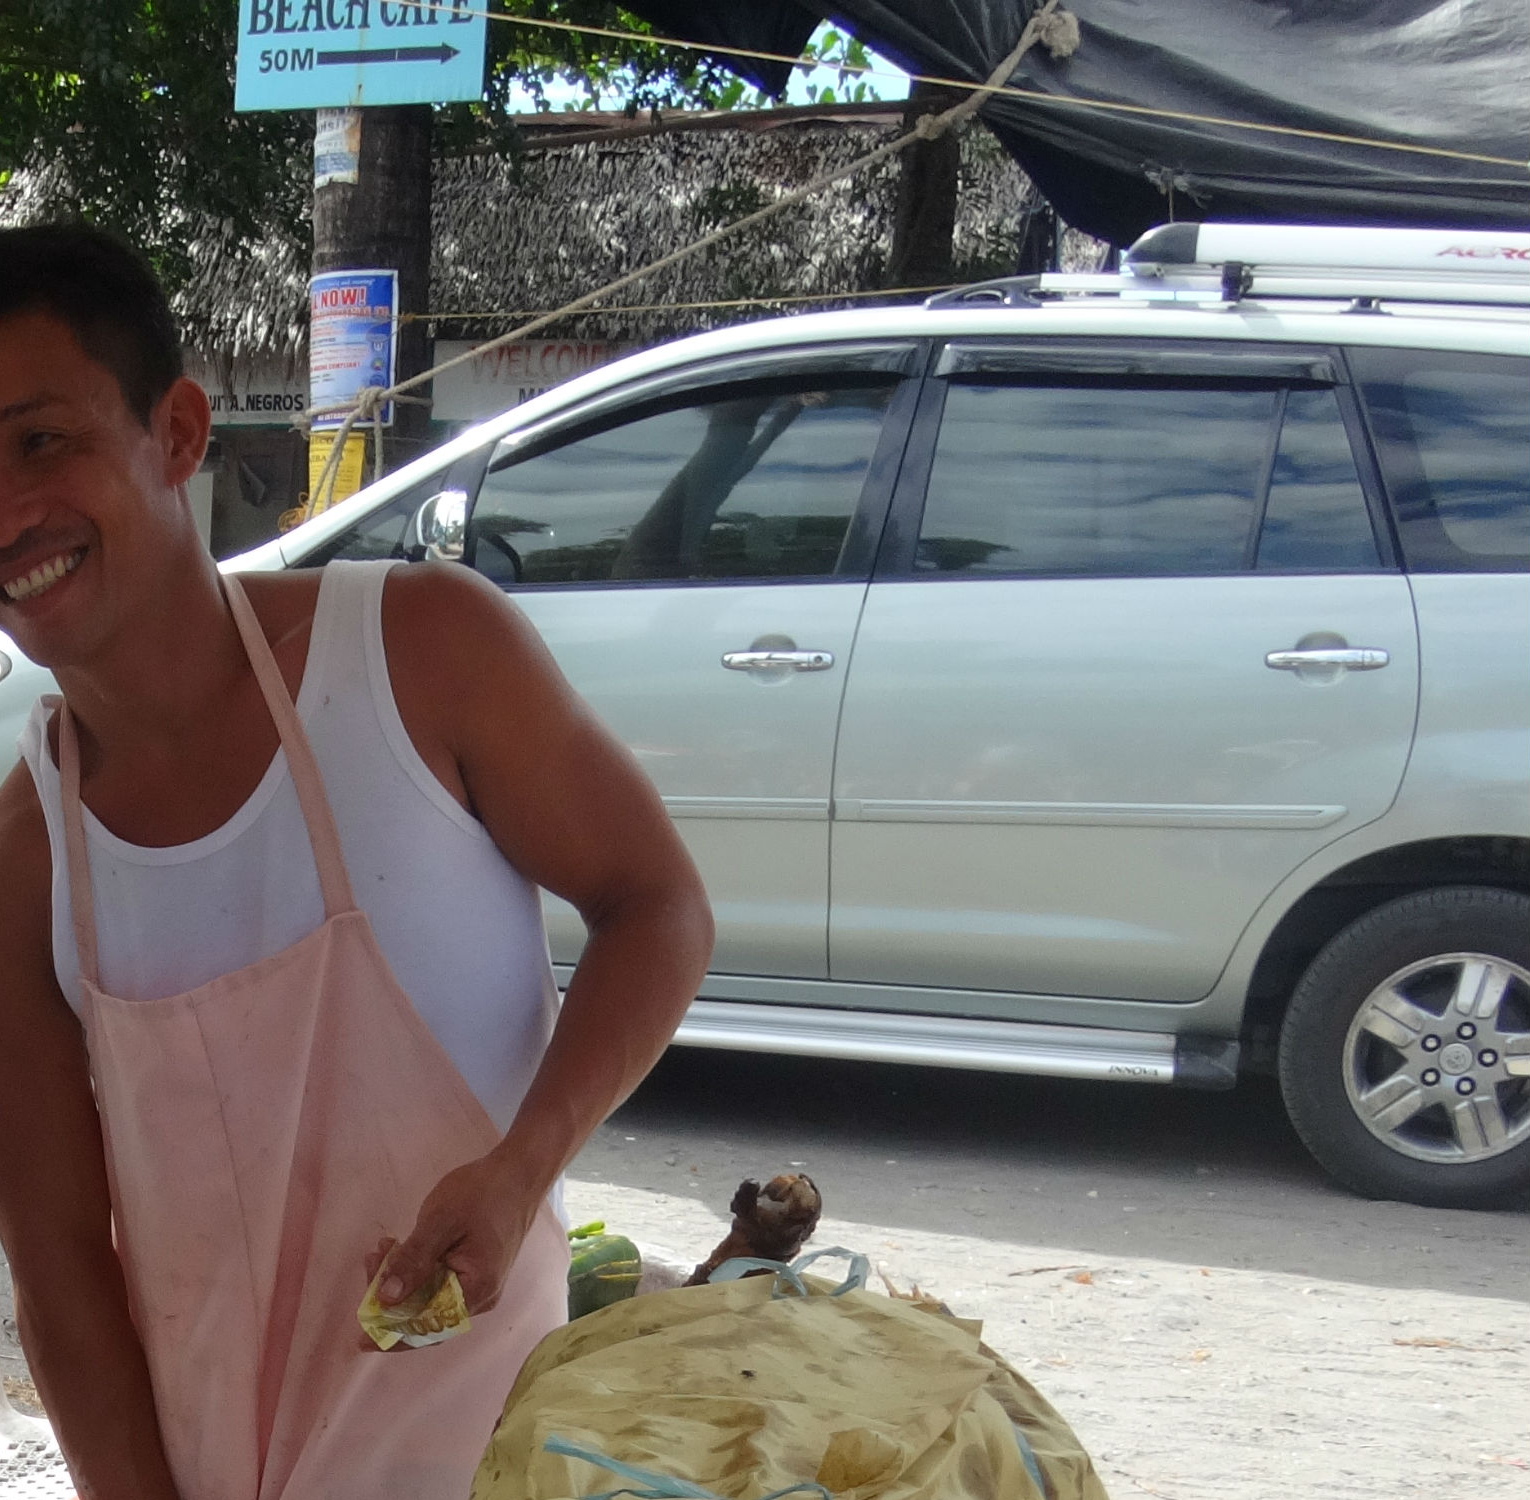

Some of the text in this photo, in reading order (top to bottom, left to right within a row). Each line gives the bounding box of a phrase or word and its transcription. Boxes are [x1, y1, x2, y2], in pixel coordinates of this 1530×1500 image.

[247, 0, 370, 35] BEACH
[258, 48, 315, 74] 50M
[321, 287, 366, 309] NOW!
[246, 393, 304, 412] NEGROS
[1108, 1065, 1159, 1077] INNOVA
